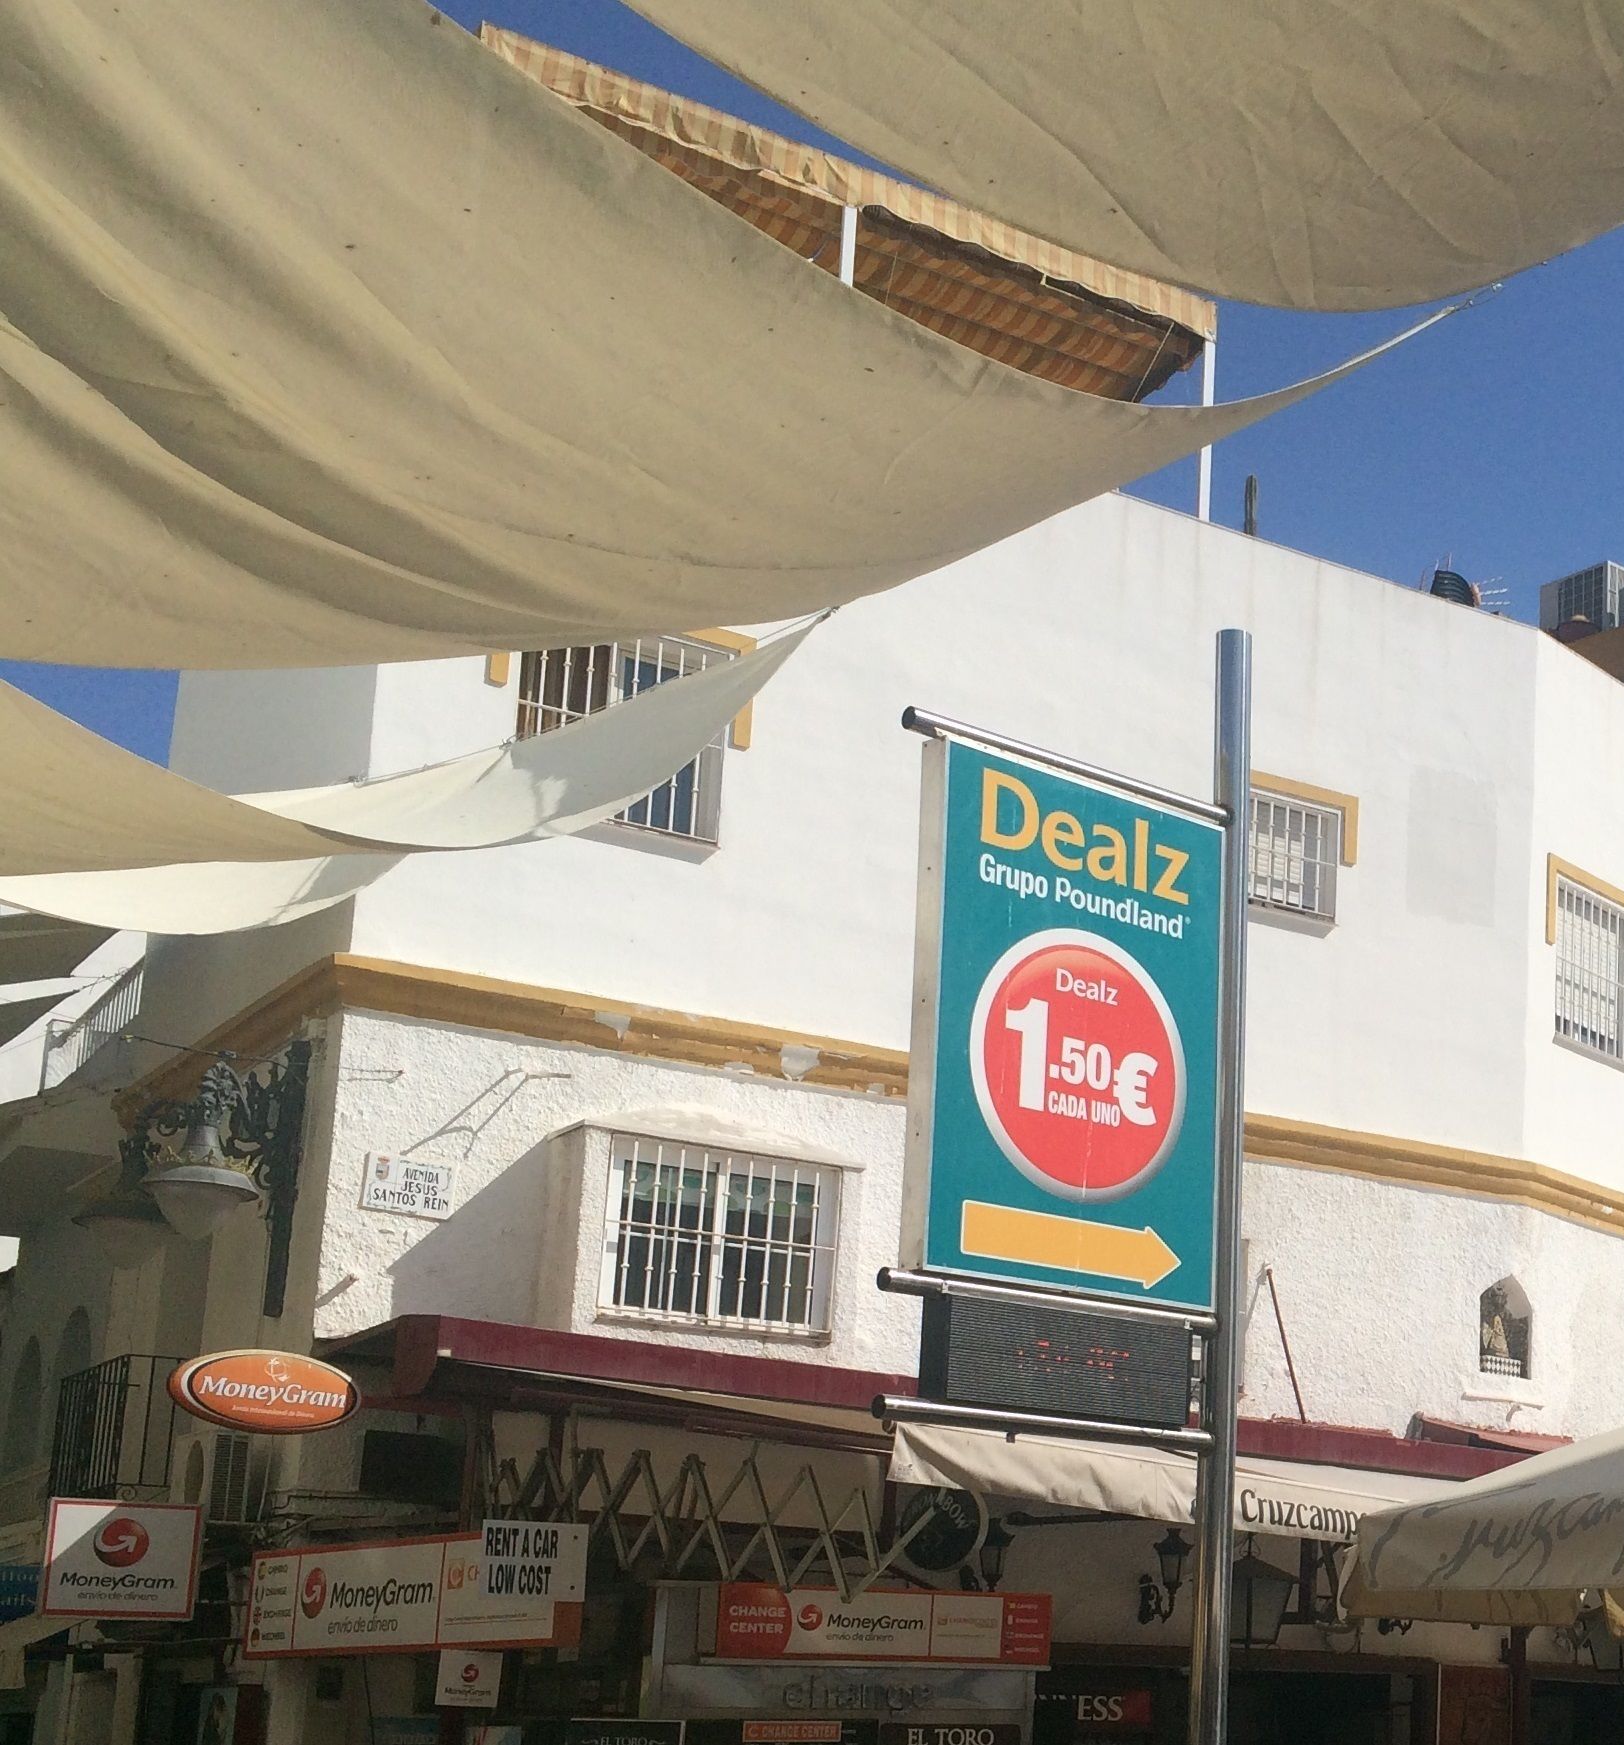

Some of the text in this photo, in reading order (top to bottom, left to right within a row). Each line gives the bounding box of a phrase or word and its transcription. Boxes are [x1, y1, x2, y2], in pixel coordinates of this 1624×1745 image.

[980, 767, 1190, 906] Dealz
[979, 852, 1184, 940] Grupo Poundland
[1055, 967, 1119, 1006] Dealz
[1048, 1090, 1121, 1128] CADA UNO
[403, 1167, 439, 1185] AVENIDA
[401, 1180, 438, 1197] JESUS
[373, 1187, 449, 1212] SANTOS REIN
[199, 1375, 347, 1409] MoneyGram
[485, 1526, 559, 1560] RENT A CAR
[59, 1572, 176, 1590] MoneyGram
[487, 1563, 517, 1595] LOW
[518, 1564, 552, 1596] COST
[329, 1578, 433, 1614] MoneyGram
[729, 1604, 787, 1619] CHANGE
[353, 1617, 366, 1633] de
[366, 1615, 399, 1633] dinero
[729, 1621, 785, 1635] CENTER
[827, 1612, 924, 1632] MoneyGram
[852, 1632, 863, 1642] de
[864, 1632, 894, 1643] dinero
[600, 1736, 648, 1745] EL TORO
[761, 1725, 798, 1739] CHANGE
[801, 1725, 836, 1739] CENTER
[908, 1728, 994, 1745] EL TORO
